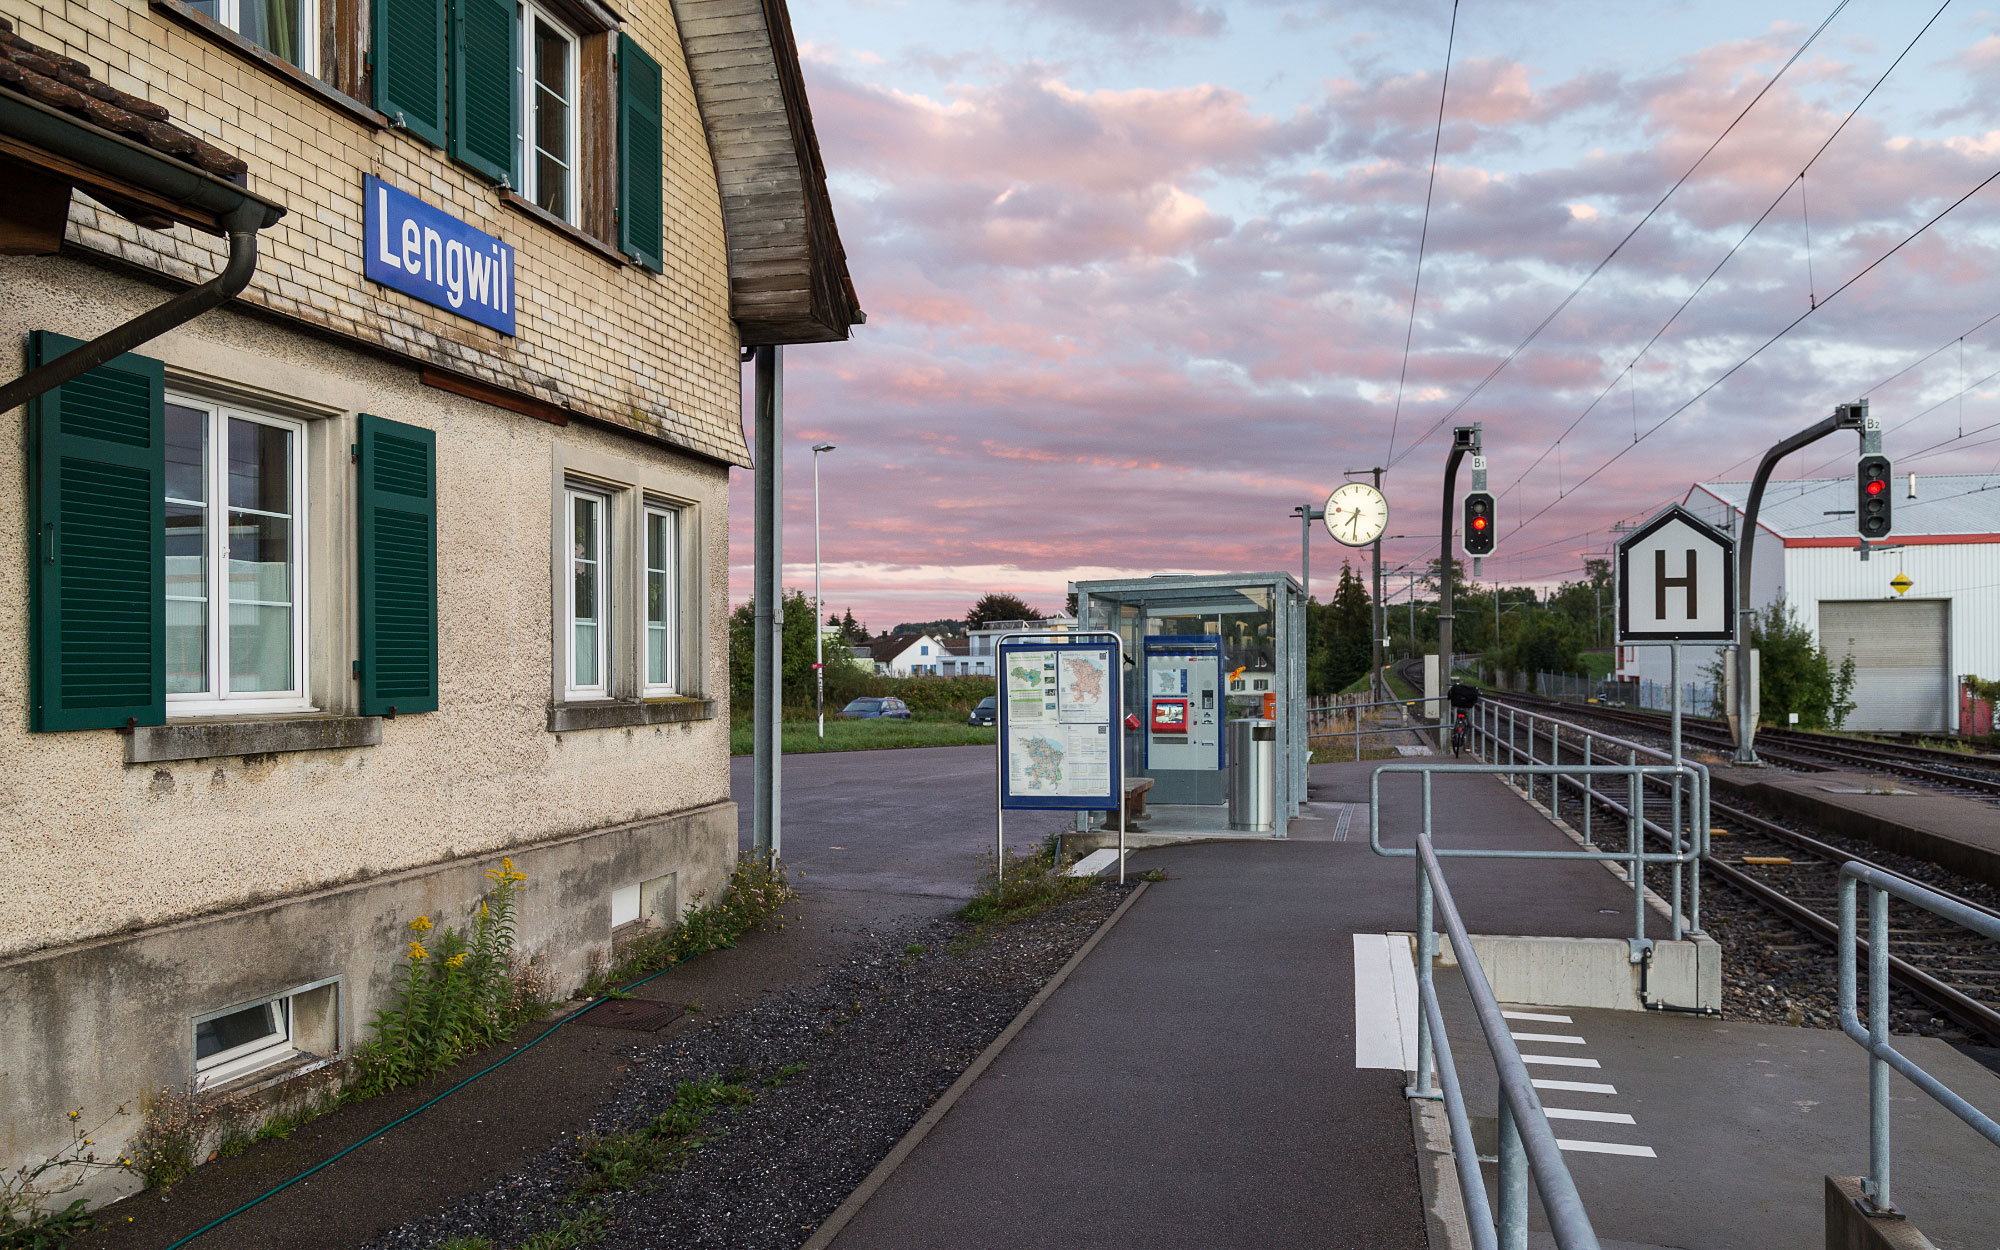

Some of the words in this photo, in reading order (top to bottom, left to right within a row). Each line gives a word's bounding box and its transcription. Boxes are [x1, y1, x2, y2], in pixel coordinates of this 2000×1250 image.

[378, 187, 508, 314] Lengwil
[1867, 418, 1880, 429] B2
[1474, 457, 1485, 468] B1
[1655, 549, 1697, 619] H
